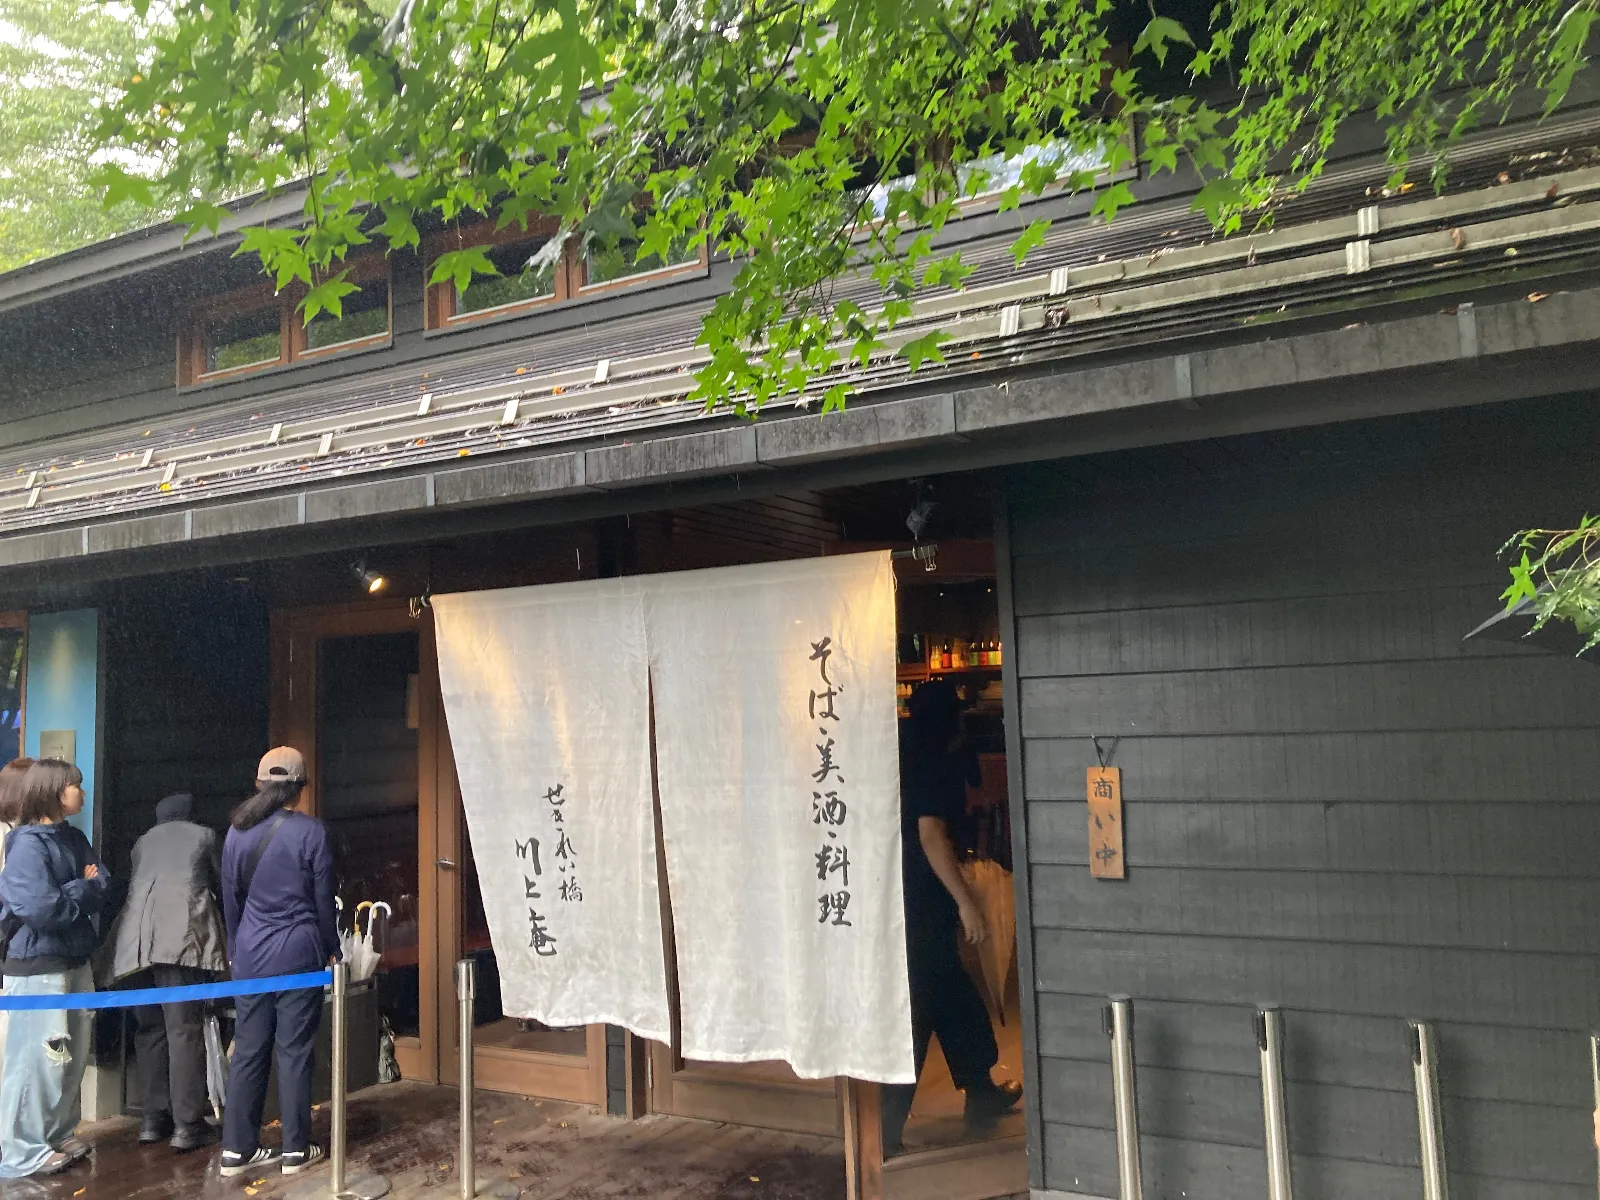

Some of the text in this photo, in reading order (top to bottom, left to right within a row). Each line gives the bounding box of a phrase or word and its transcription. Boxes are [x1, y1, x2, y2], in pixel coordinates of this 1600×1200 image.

[1093, 777, 1117, 869] 商い中
[515, 837, 558, 956] 川上庵
